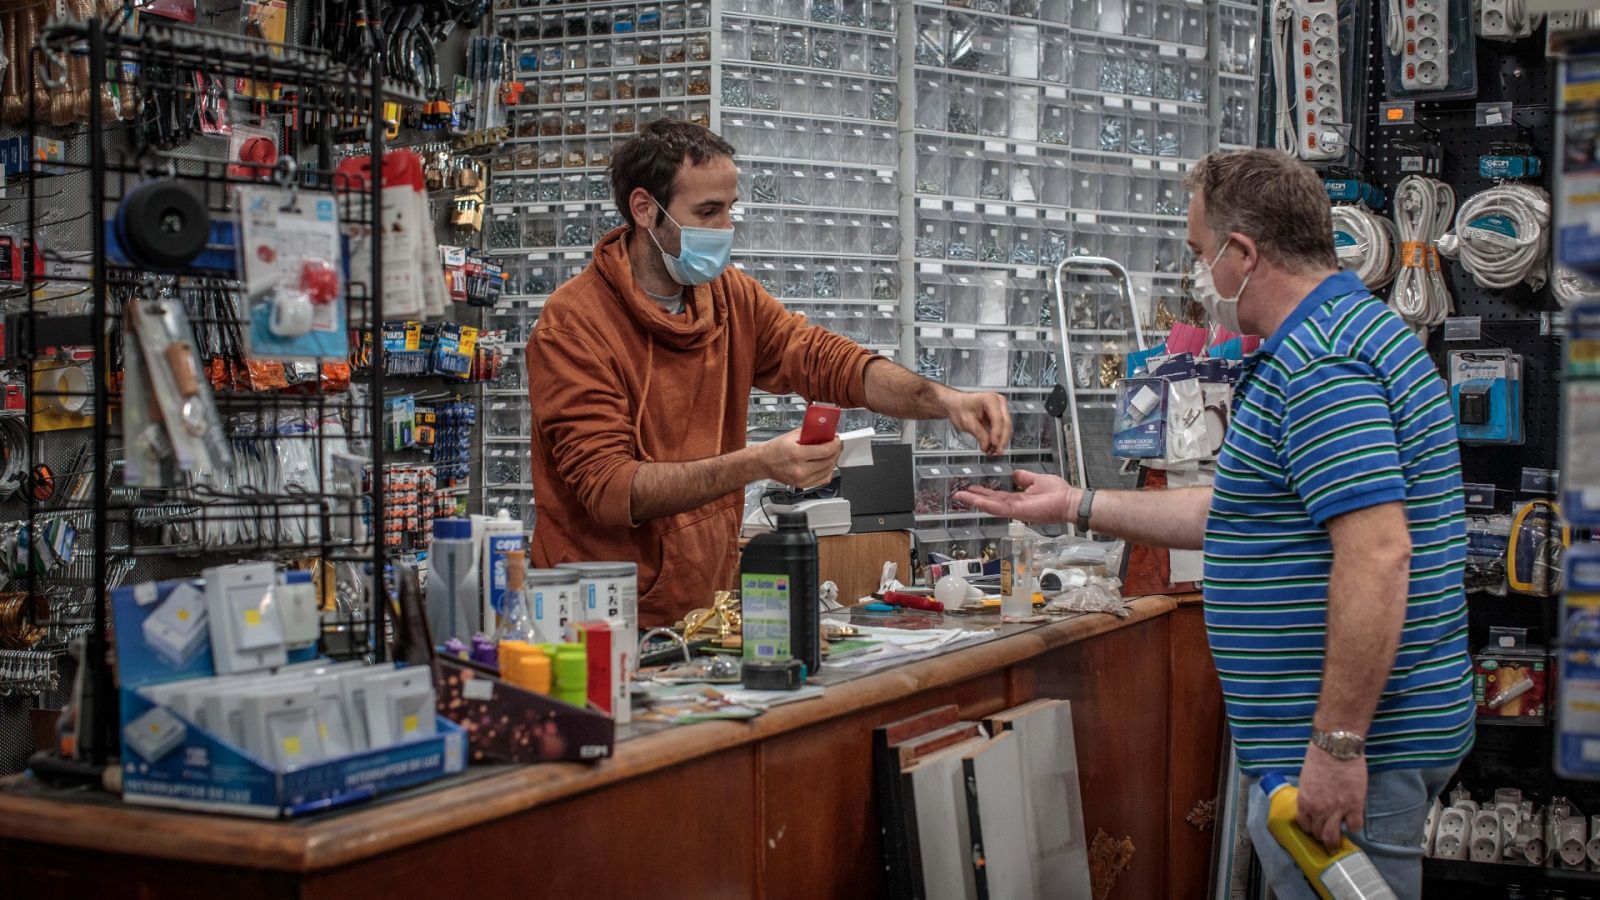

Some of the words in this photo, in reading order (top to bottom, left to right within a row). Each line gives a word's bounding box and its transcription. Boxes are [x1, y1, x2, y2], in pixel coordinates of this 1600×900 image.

[1331, 182, 1346, 190] EDM
[387, 331, 404, 339] VARTA
[495, 540, 522, 551] ceys
[346, 762, 409, 786] INTERRUPTOR
[127, 779, 205, 798] INTERRUPTOR
